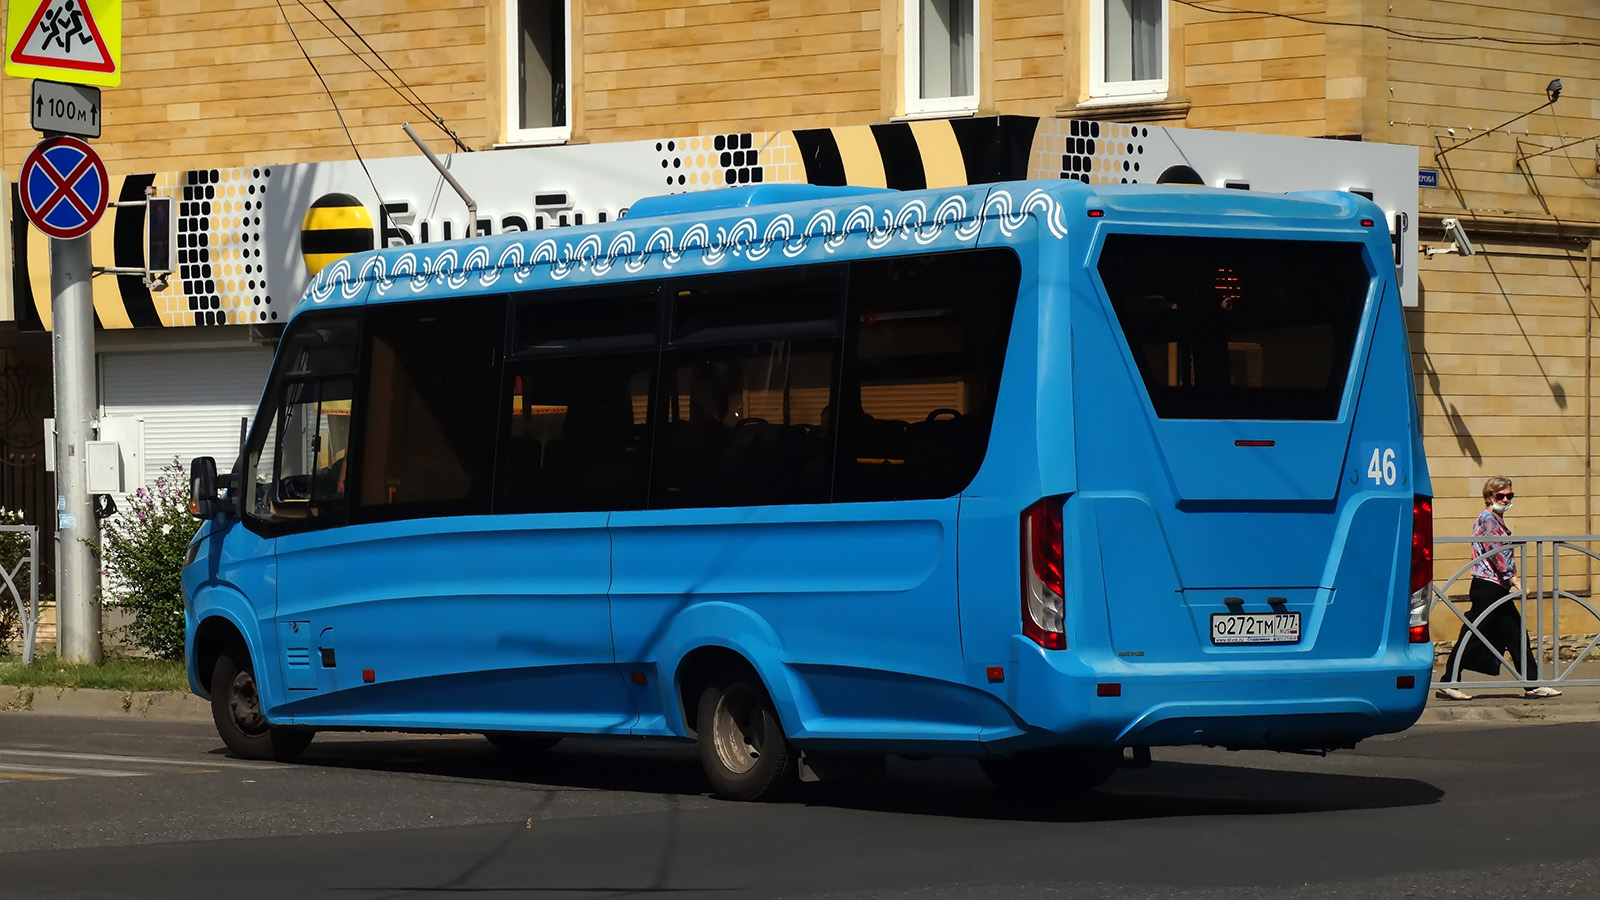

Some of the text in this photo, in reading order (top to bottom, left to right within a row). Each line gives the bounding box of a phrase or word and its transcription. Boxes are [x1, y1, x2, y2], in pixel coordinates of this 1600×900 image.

[1367, 448, 1396, 485] 46
[1217, 615, 1295, 634] О272ТМ 777
